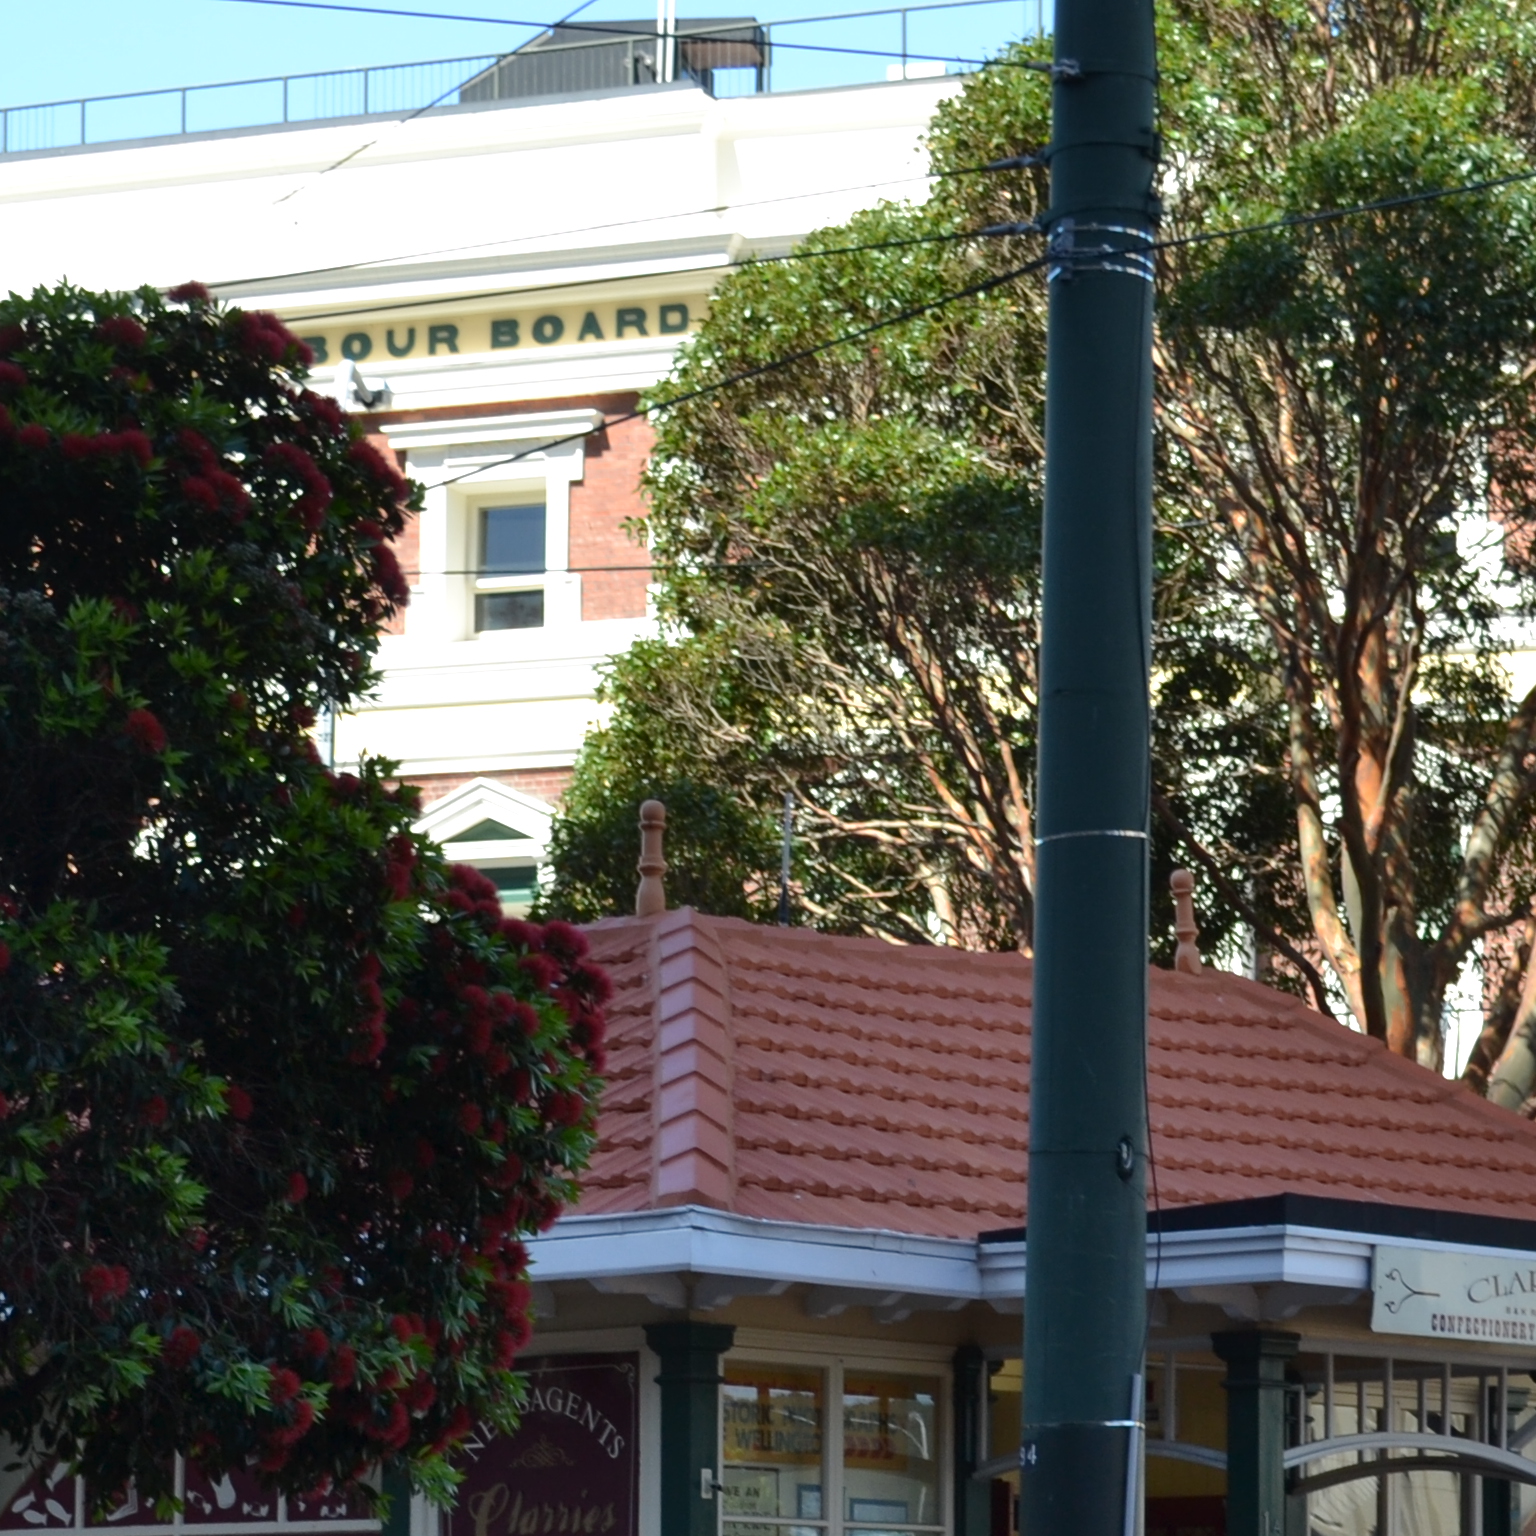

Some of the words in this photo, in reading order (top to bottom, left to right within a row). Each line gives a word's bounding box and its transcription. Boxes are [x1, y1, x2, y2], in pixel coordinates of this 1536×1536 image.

[490, 303, 690, 349] BOARD
[1431, 1313, 1536, 1342] CONFECTIONERY
[463, 1386, 626, 1462] NESAGENTS
